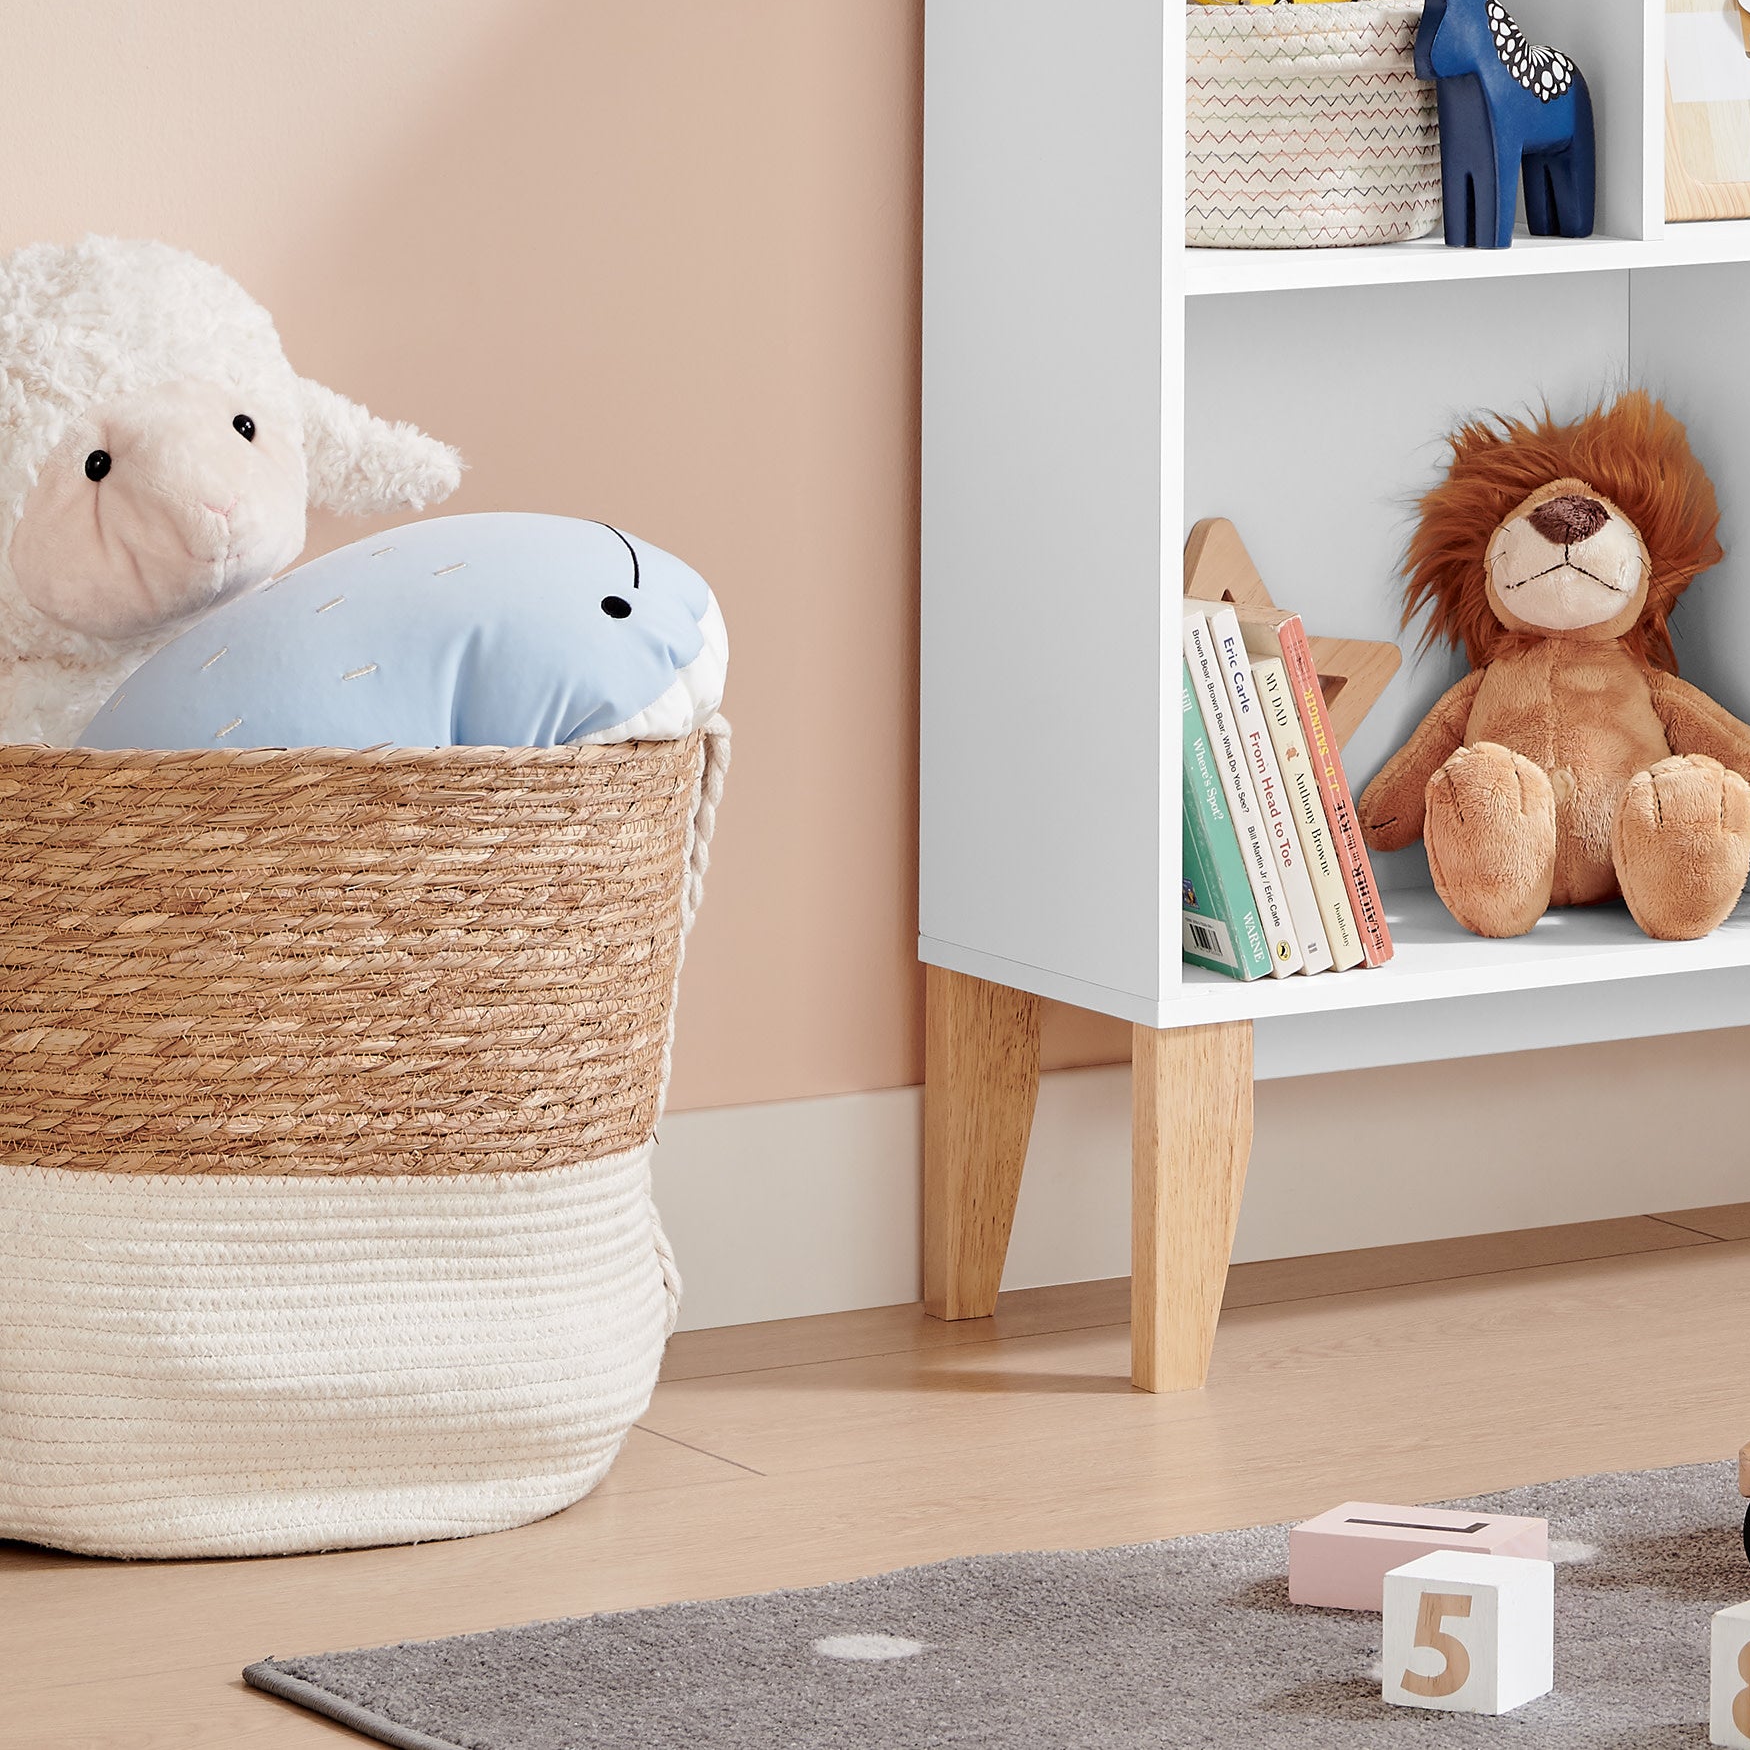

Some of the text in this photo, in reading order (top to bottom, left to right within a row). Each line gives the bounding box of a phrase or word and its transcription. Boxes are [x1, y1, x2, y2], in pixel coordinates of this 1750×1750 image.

[1264, 672, 1289, 727] MY DAD
[1304, 687, 1330, 756] SALINGER
[1192, 629, 1281, 928] Brown Bear, Brown Bear, What Do You See? Bill Martin Jr Eric Carle
[1192, 737, 1225, 821] Where's Spot?
[1223, 636, 1293, 868] Eric Carle From Head to Toe
[1295, 772, 1331, 878] Anthony Browne
[1333, 799, 1352, 834] RYE
[1333, 901, 1350, 948] Doubleday
[1351, 861, 1380, 934] CATCHER
[1242, 911, 1265, 964] WARNE
[1372, 932, 1385, 951] the
[1400, 1592, 1473, 1698] 5
